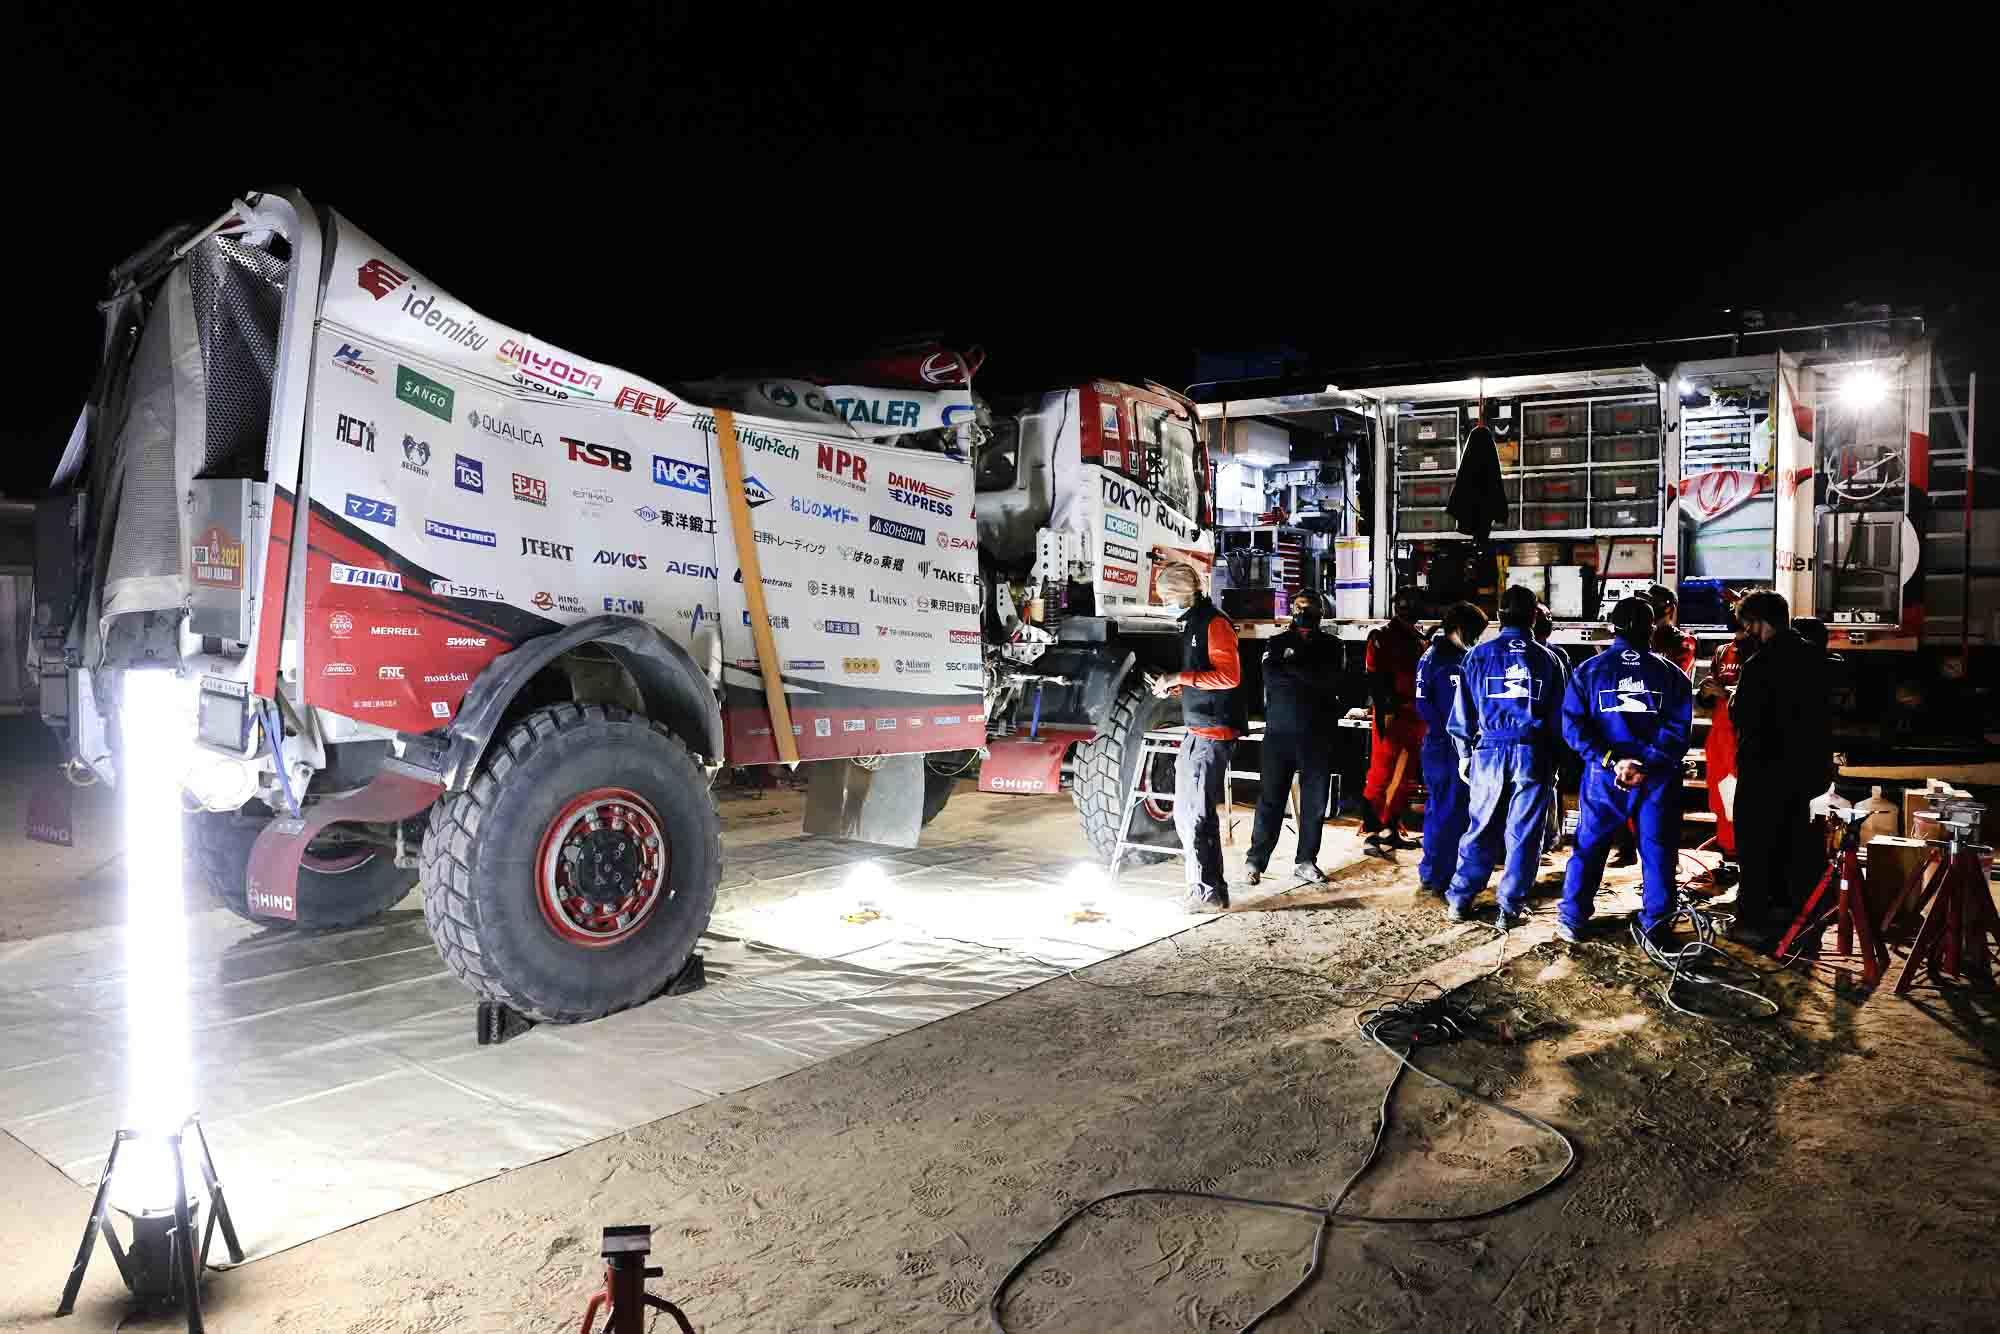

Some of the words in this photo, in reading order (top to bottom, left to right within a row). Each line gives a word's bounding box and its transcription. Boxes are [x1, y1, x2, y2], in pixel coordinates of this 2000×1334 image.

[402, 285, 488, 352] idemitsu
[498, 339, 603, 391] CHIYODA
[404, 381, 446, 408] SANGO
[512, 373, 569, 400] Group
[614, 386, 677, 421] FEV
[804, 392, 921, 428] CATALER
[482, 414, 543, 448] QUALICA
[560, 437, 632, 473] TSB
[816, 442, 867, 483] NPR
[655, 459, 708, 489] NOK
[888, 472, 928, 495] DAIWA
[744, 487, 766, 500] ANA
[894, 489, 953, 517] EXPRESS
[1100, 474, 1150, 518] TOKYO
[883, 521, 924, 543] SOHSHIN
[521, 536, 573, 561] JTEKT
[666, 561, 719, 579] AISIN
[450, 585, 504, 600] トヨタホーム
[558, 595, 579, 604] HINO
[371, 627, 421, 636] MERRELL
[446, 637, 488, 646] SWANS
[1005, 778, 1044, 790] HINO
[260, 894, 294, 913] HINO
